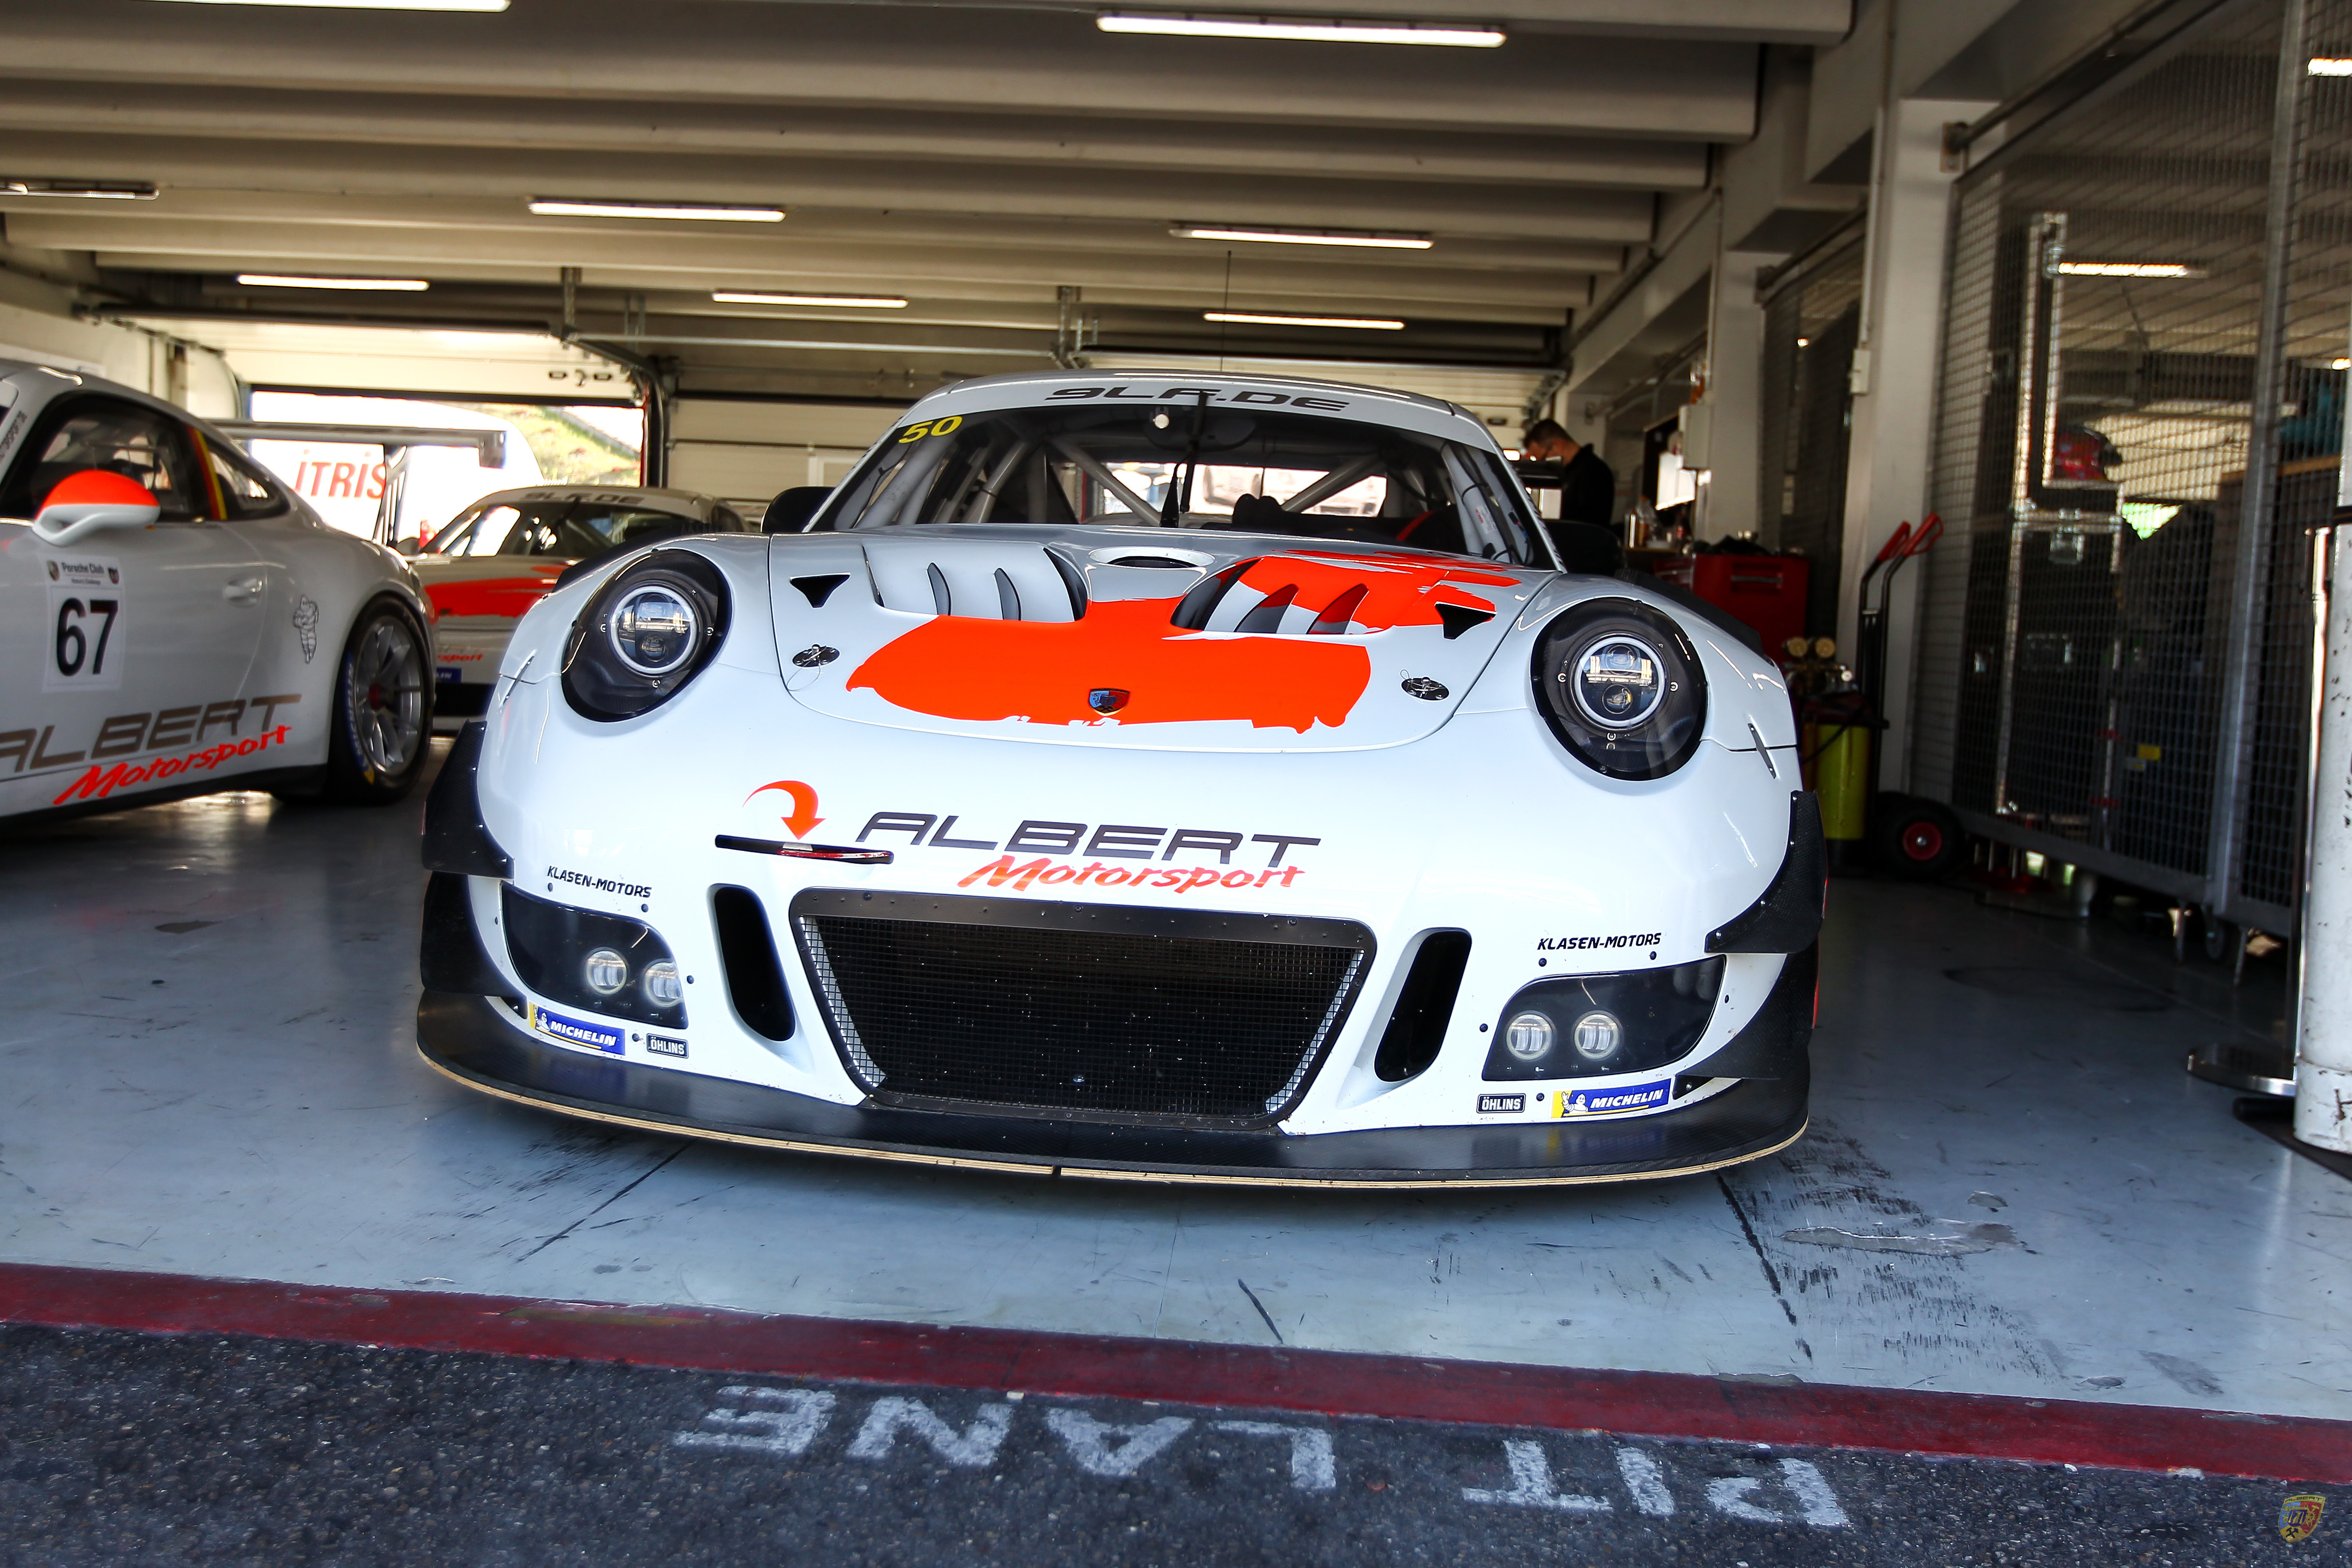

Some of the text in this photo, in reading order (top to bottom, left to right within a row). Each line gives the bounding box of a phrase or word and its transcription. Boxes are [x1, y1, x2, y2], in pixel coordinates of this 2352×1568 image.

[898, 416, 962, 444] 50
[57, 597, 119, 676] 67
[53, 724, 292, 805] Motorsport
[855, 812, 1321, 868] ALBERT
[547, 866, 652, 898] KLASEN-MOTORS
[958, 855, 1306, 894] Motorsport
[1537, 932, 1662, 950] KLASEN-MOTORS
[550, 1021, 617, 1046] MICHELIN
[650, 1036, 685, 1055] ÖHLINS
[1482, 1096, 1521, 1111] ÖHLINS
[1590, 1089, 1664, 1109] MICHELIN
[673, 1385, 1851, 1527] PIT LANE
